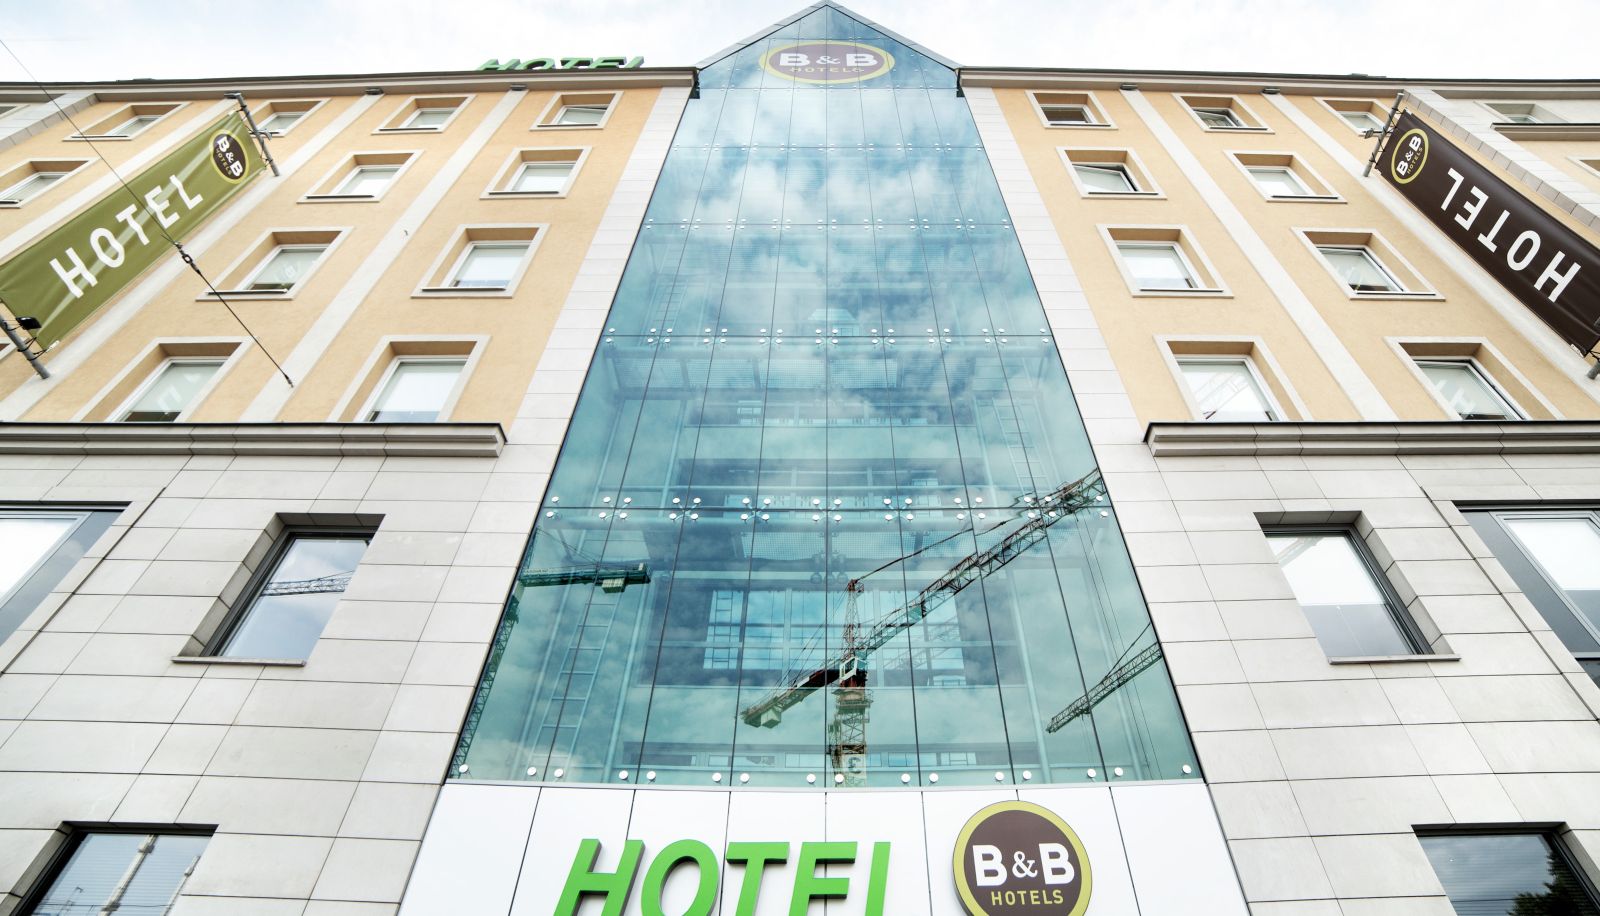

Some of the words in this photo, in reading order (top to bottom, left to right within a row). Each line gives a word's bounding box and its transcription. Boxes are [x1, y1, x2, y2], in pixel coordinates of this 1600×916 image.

[216, 147, 233, 175] HOTELS
[1406, 147, 1423, 174] HOTELS
[49, 174, 203, 299] HOTEL
[1440, 167, 1582, 303] HOTEL
[972, 843, 1075, 887] B&B
[991, 889, 1064, 906] HOTELS
